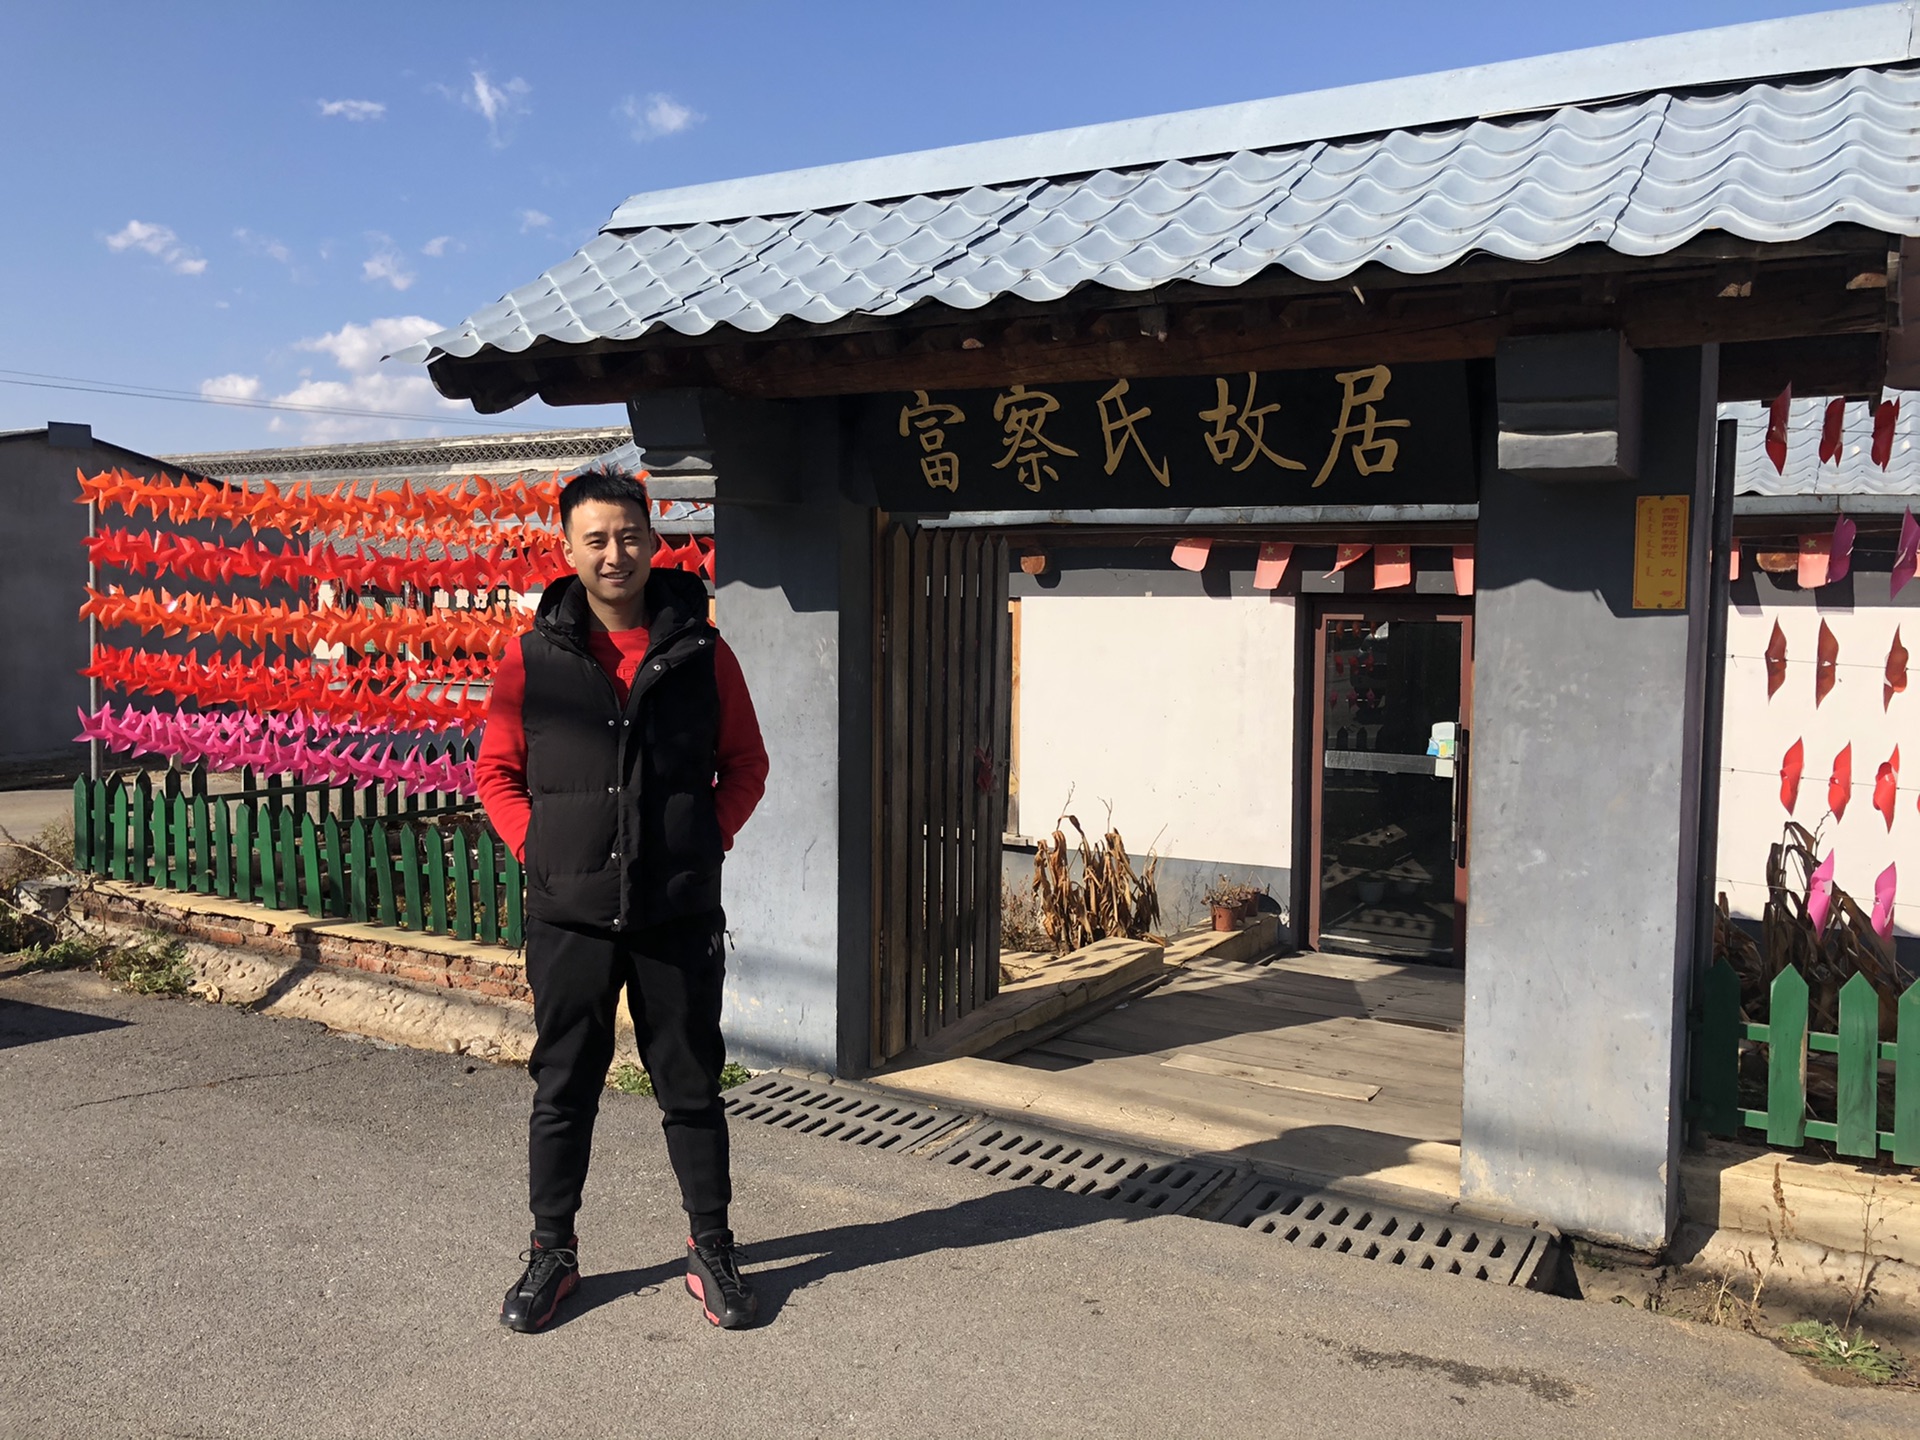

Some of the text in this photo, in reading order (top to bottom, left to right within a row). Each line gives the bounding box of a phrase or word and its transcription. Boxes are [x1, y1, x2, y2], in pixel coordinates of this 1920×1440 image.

[899, 365, 1411, 493] 富察氏故居
